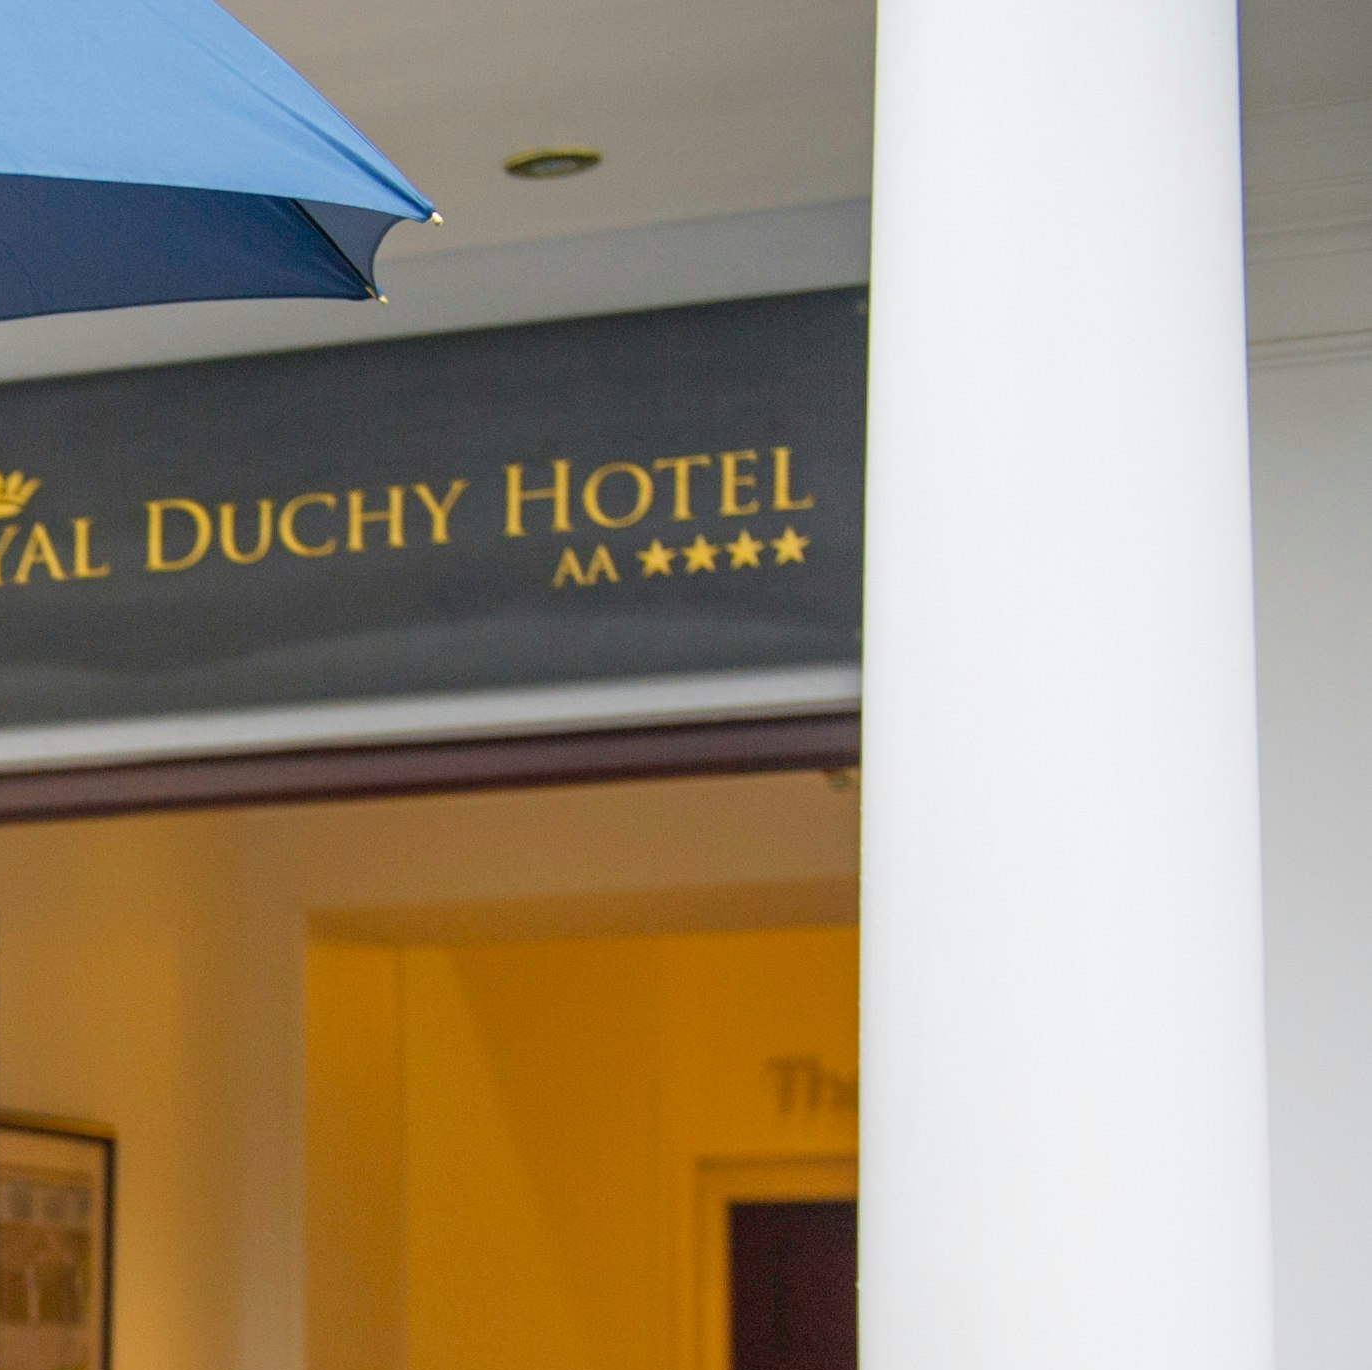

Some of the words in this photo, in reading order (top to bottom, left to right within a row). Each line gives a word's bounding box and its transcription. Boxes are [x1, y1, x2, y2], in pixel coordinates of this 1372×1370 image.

[144, 478, 468, 574] DUCHY
[503, 445, 815, 538] HOTEL
[553, 543, 621, 588] AA
